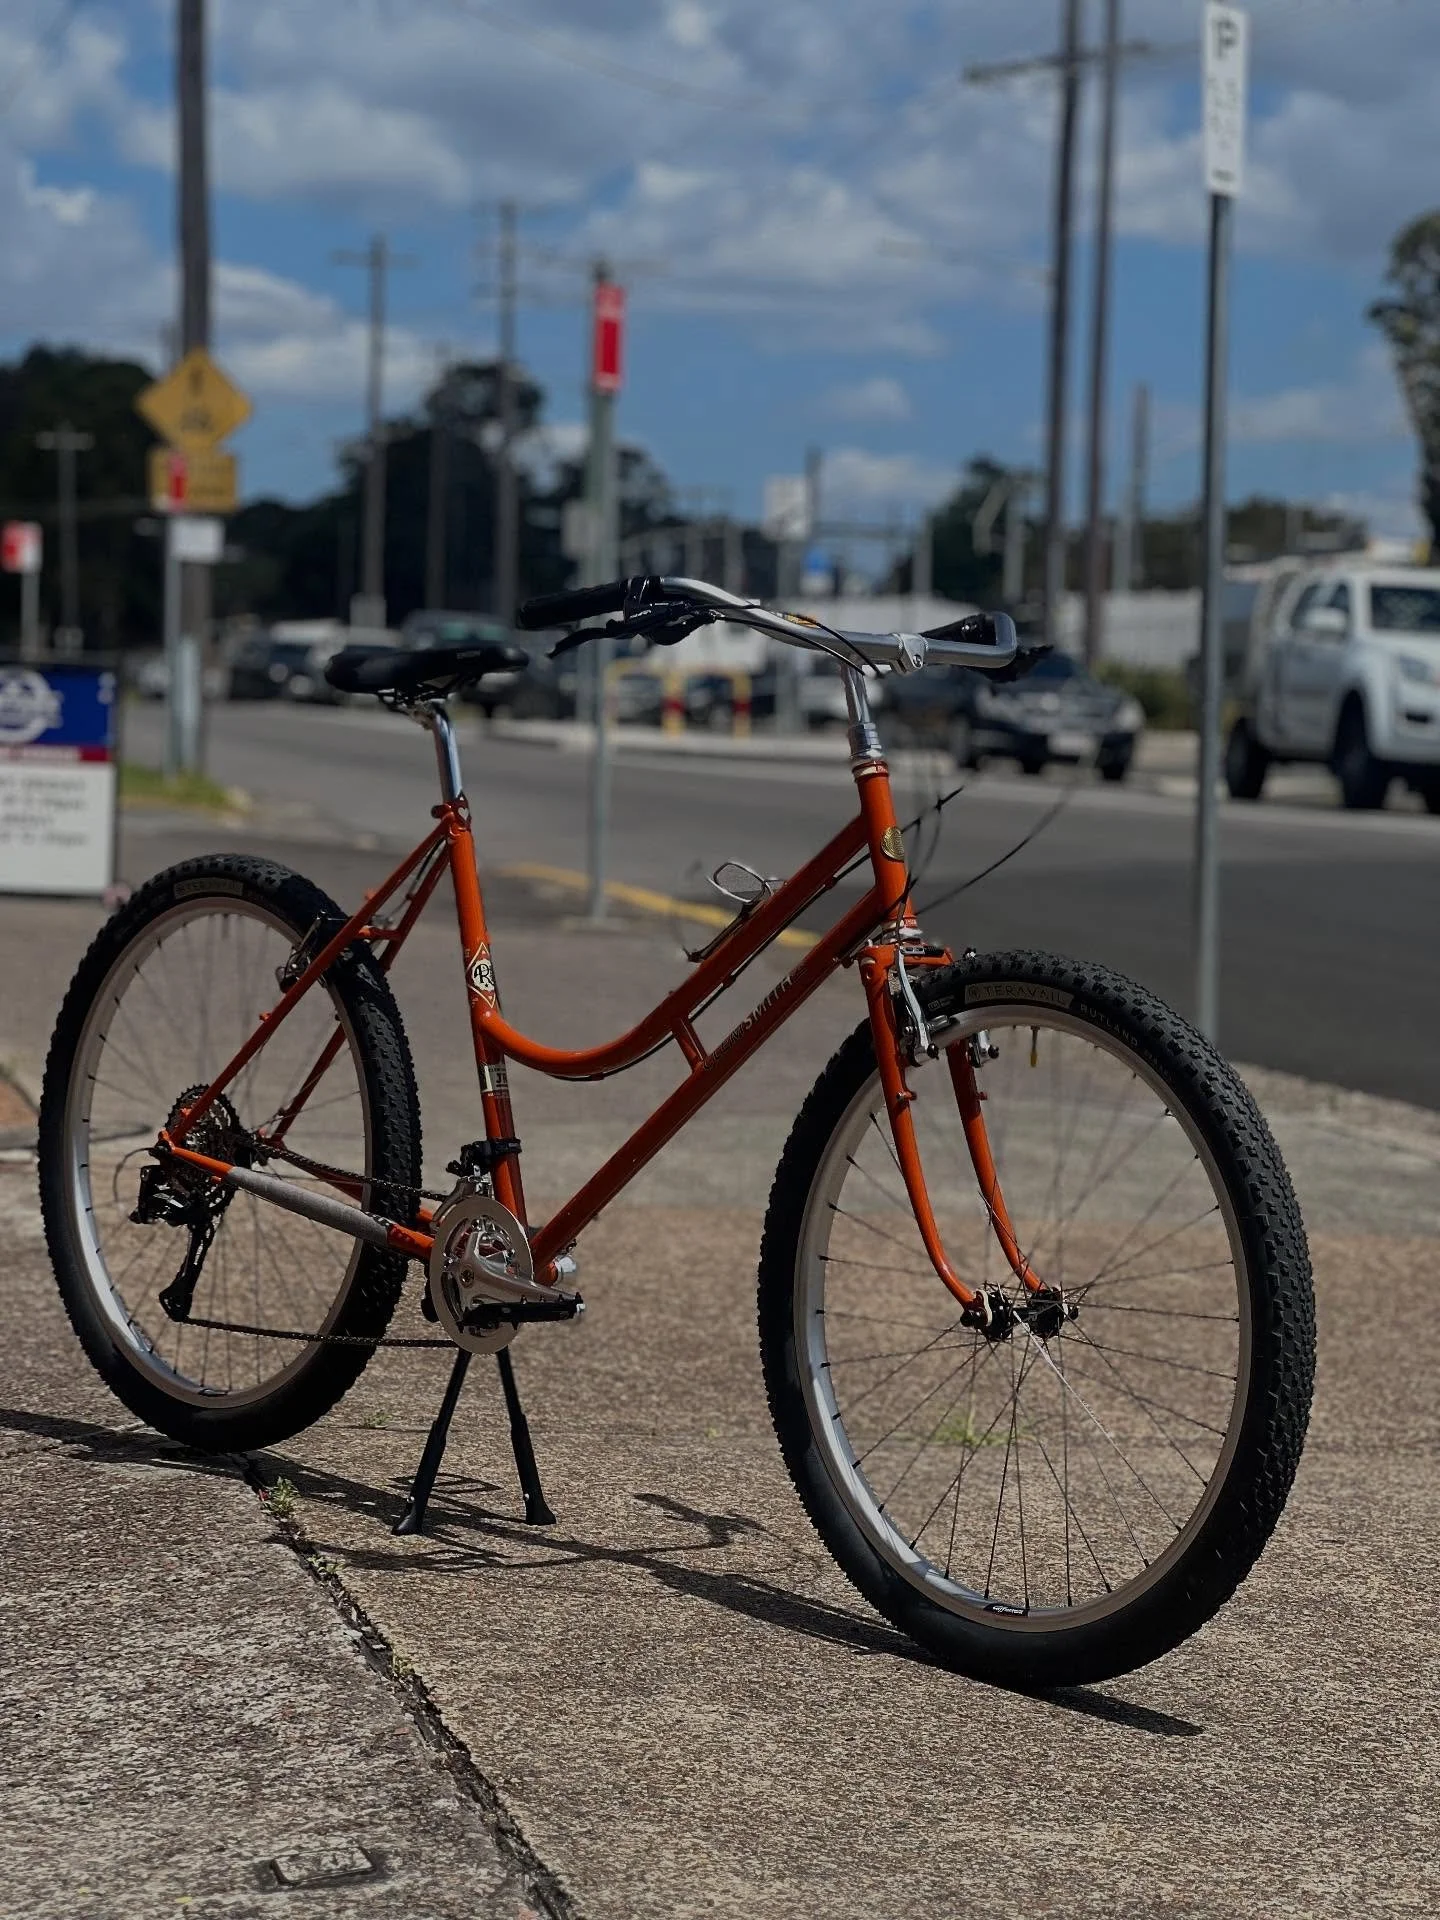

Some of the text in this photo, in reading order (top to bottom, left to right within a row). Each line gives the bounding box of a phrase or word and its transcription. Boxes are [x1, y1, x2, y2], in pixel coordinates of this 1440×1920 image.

[743, 974, 794, 1030] SMITH
[984, 984, 1065, 1005] TERAVAIL
[1079, 1002, 1139, 1047] RUTLAND
